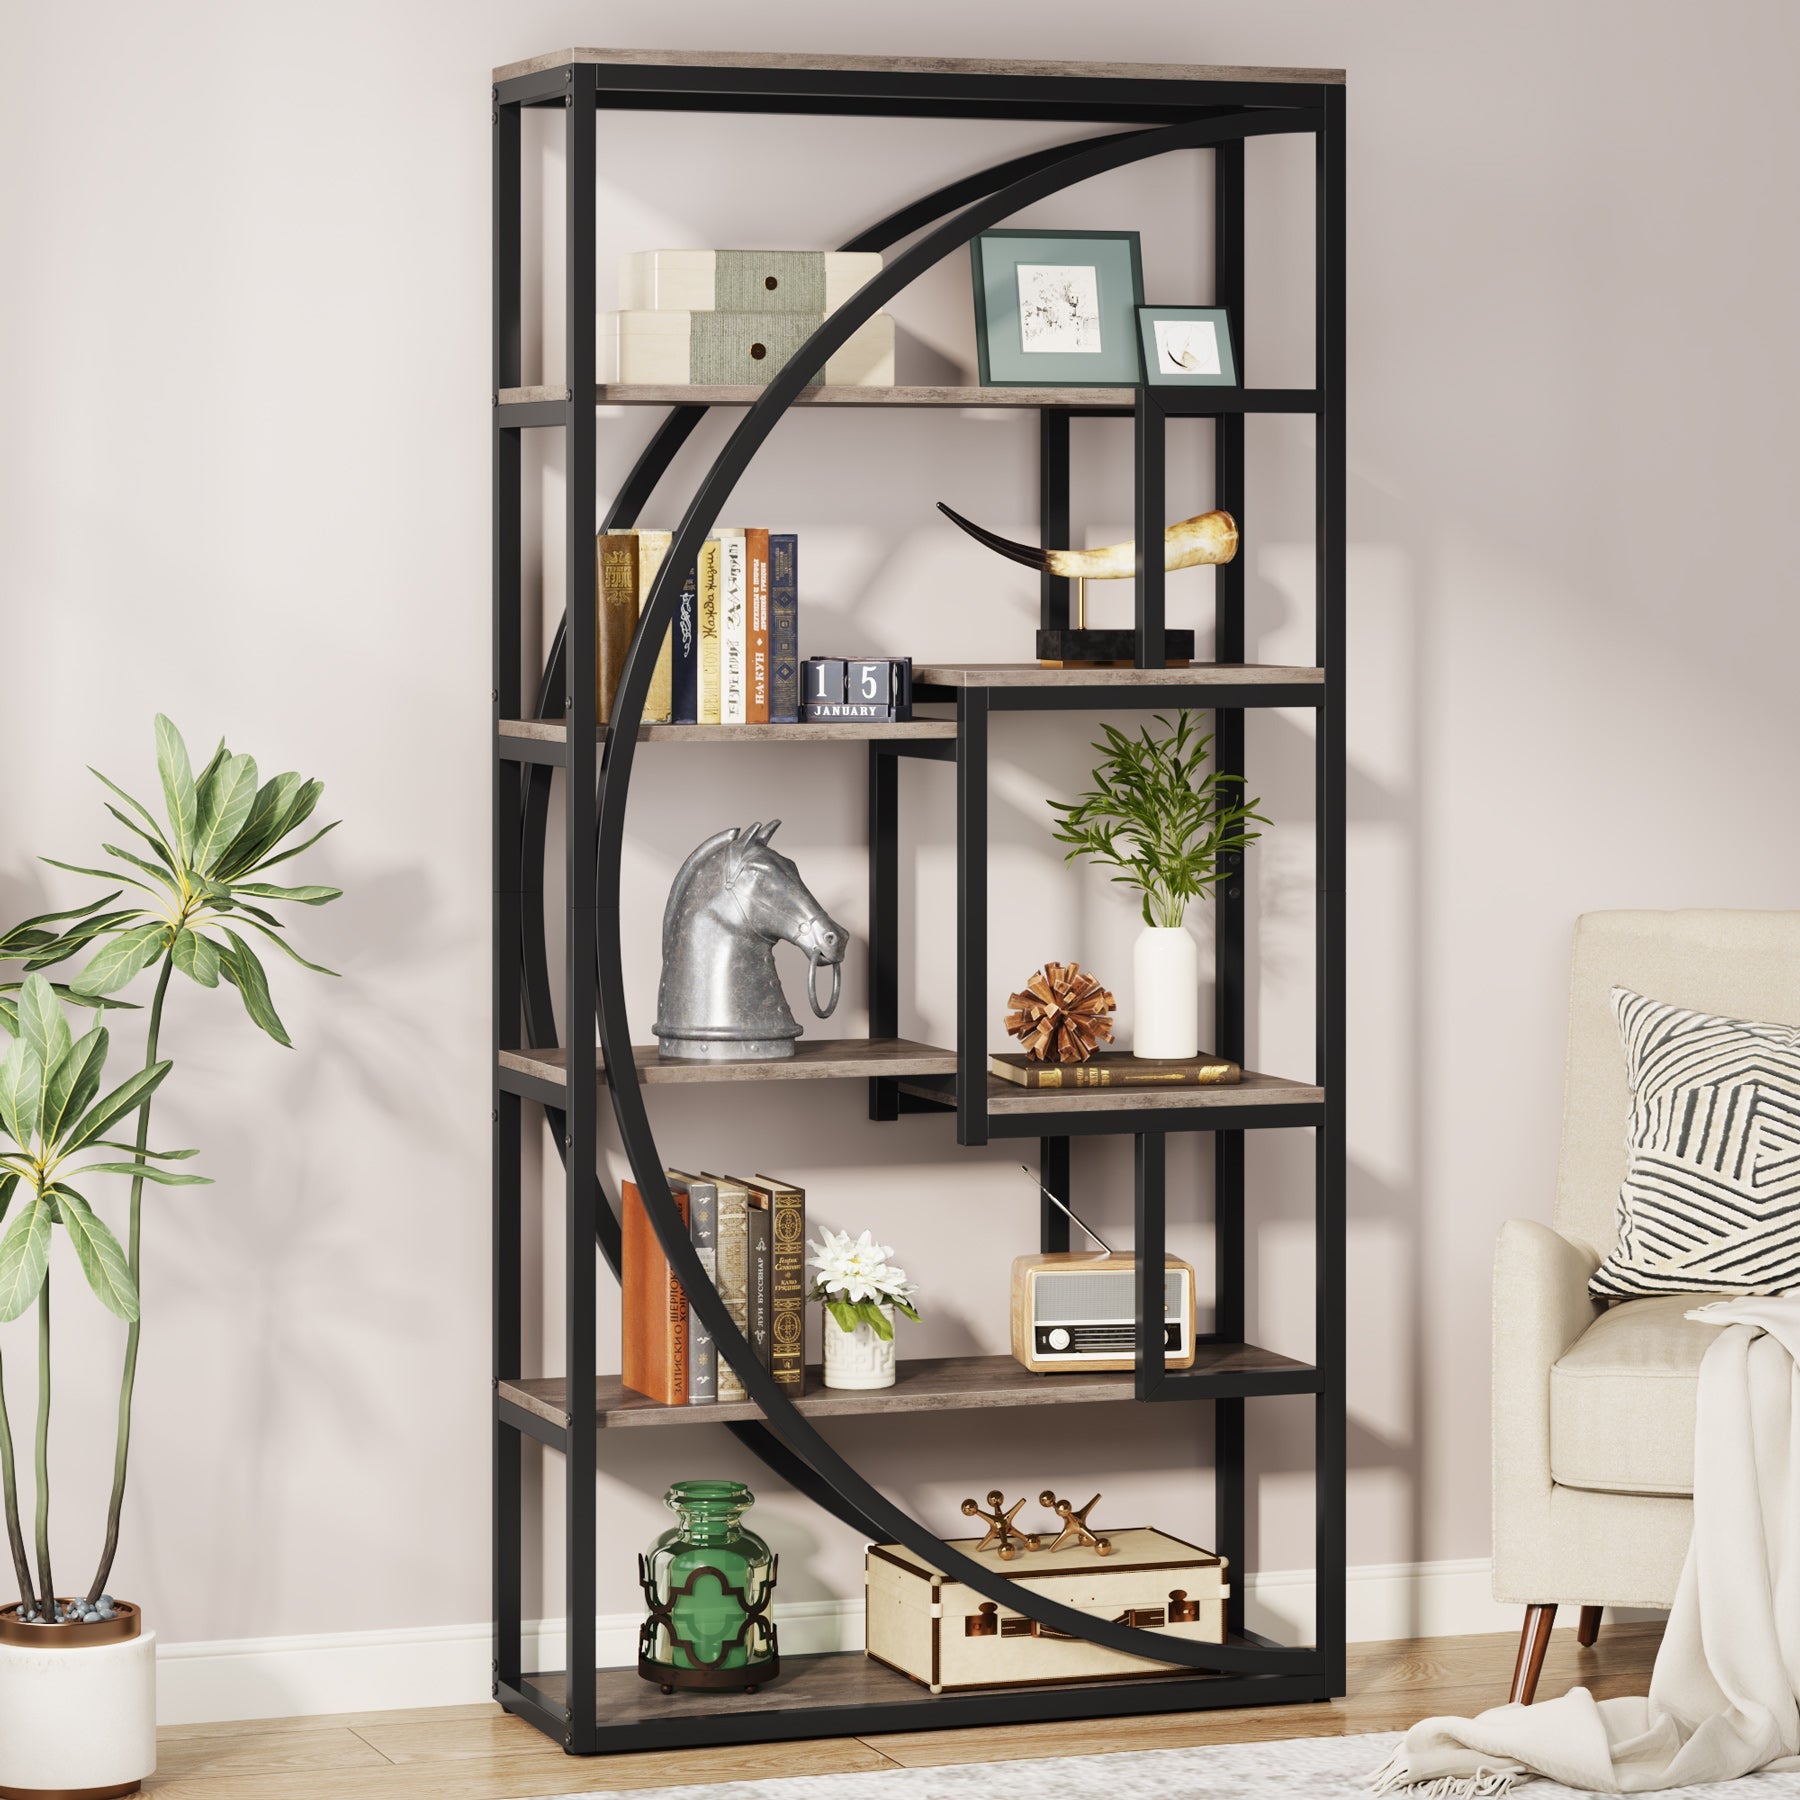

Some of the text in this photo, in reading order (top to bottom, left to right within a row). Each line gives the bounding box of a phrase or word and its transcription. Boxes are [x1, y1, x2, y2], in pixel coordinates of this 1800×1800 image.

[702, 548, 717, 639] Жажда жизни
[816, 664, 877, 699] 1 5
[814, 706, 877, 716] JANUARY
[674, 1324, 683, 1396] ЗАПИСКИ О
